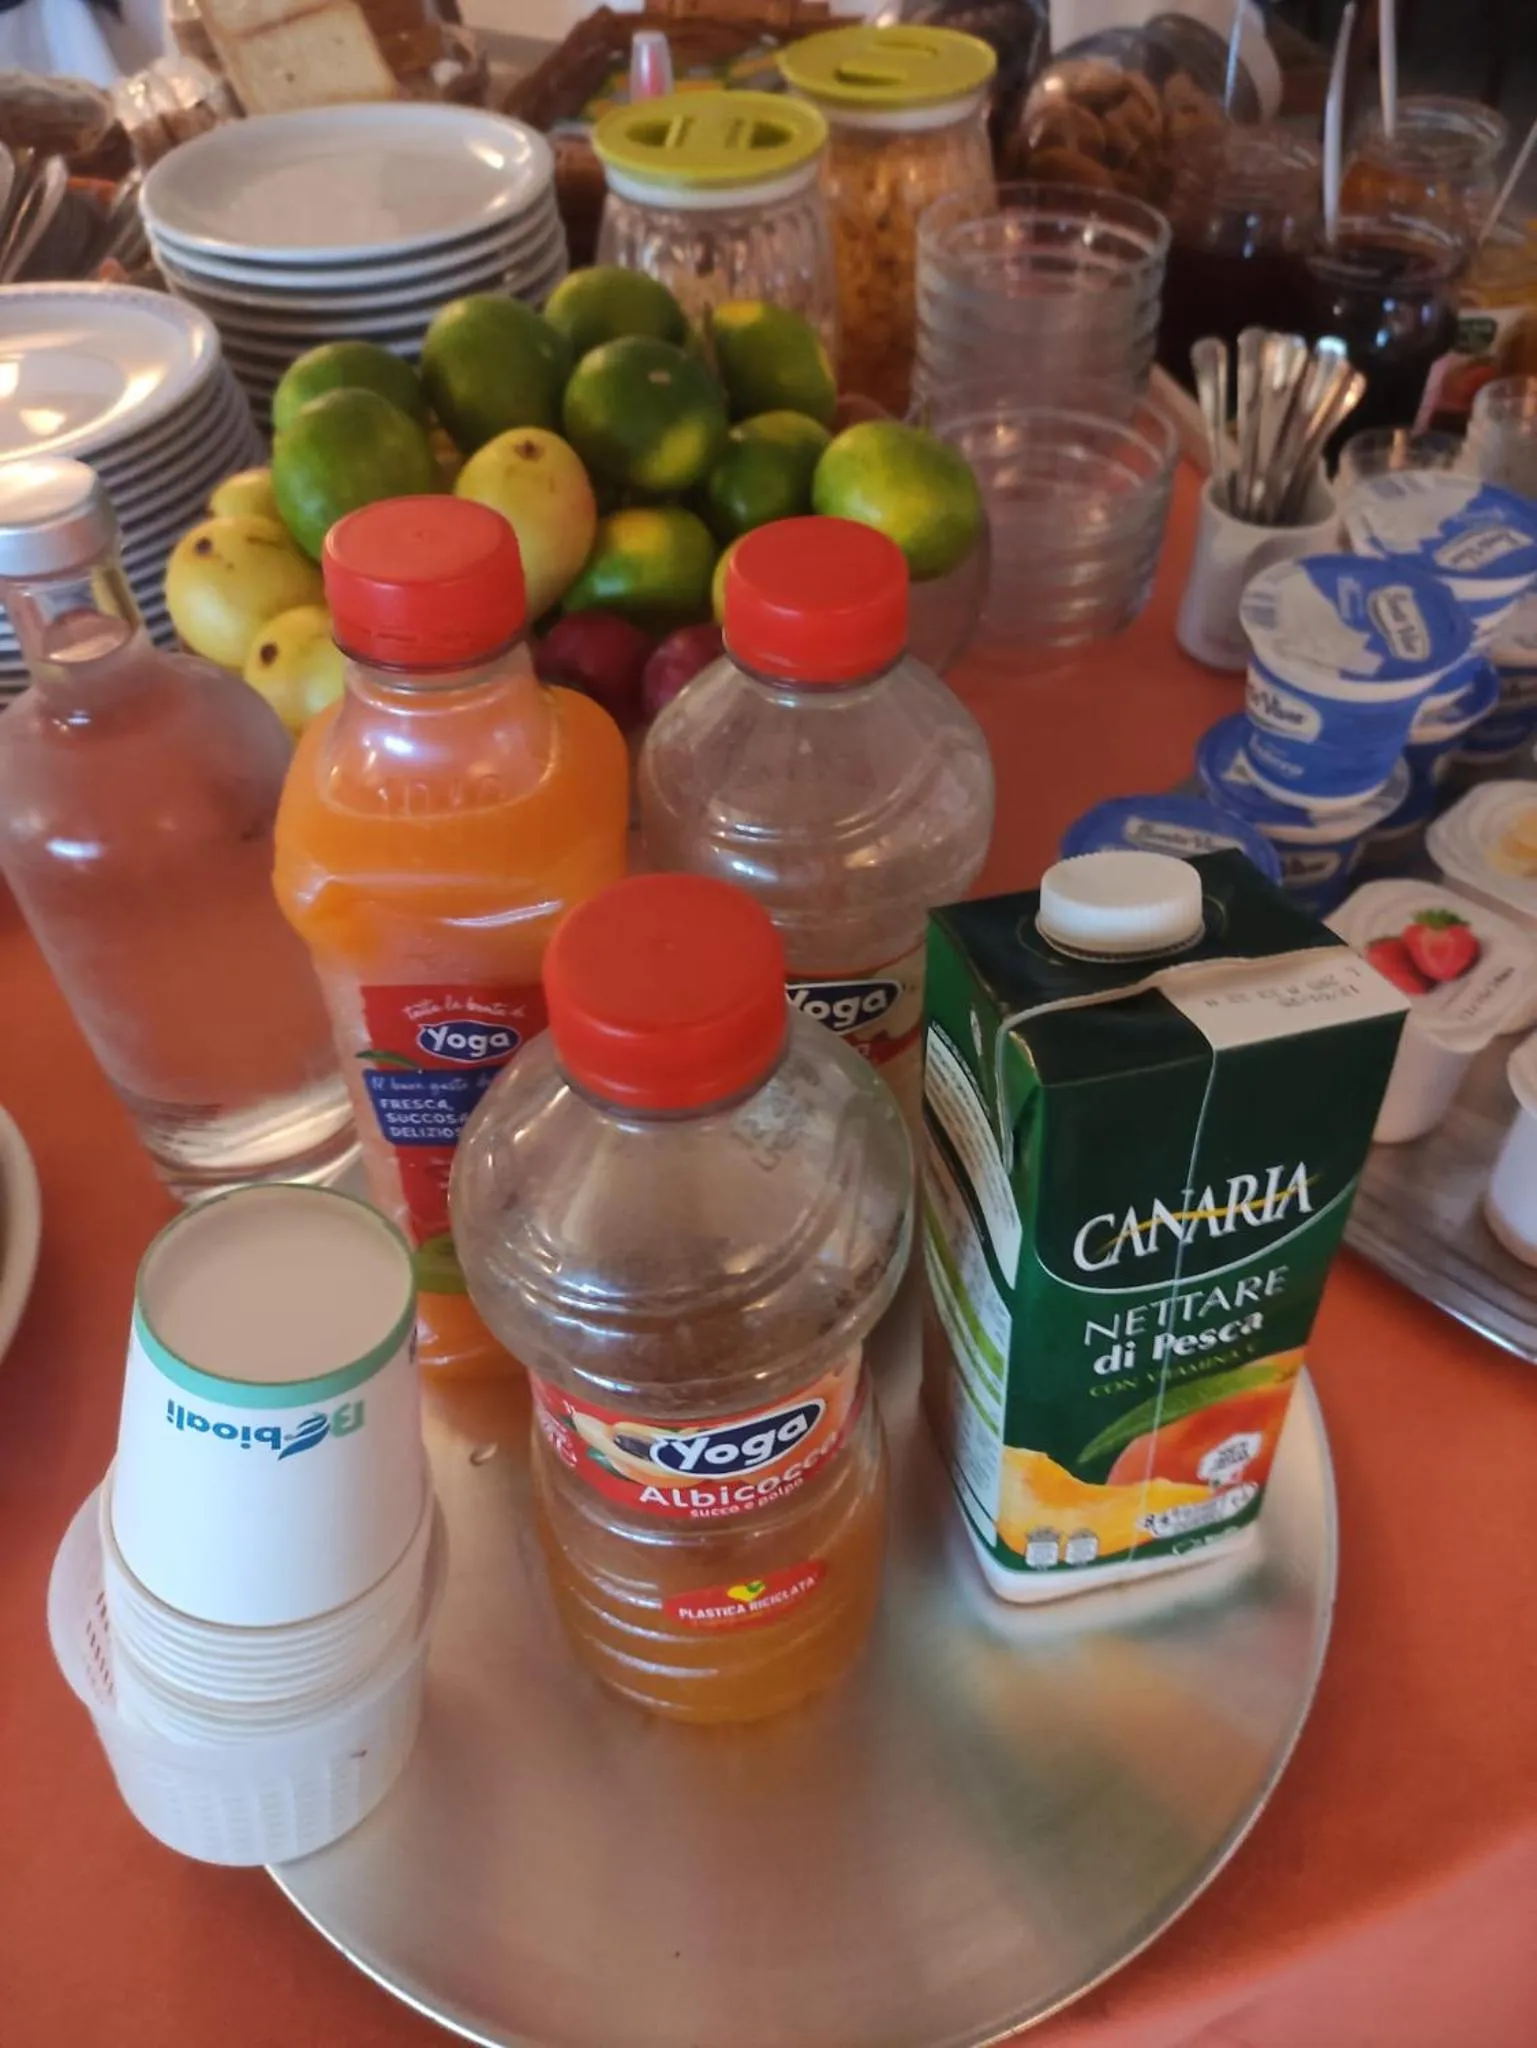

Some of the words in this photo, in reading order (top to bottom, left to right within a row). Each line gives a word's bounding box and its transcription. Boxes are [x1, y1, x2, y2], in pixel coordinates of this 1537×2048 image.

[427, 1026, 511, 1058] Yoga
[1073, 1161, 1314, 1272] CANARIA
[1084, 1265, 1289, 1346] NETTARE
[1093, 1341, 1136, 1375] di
[1152, 1311, 1264, 1360] Pesca
[671, 1413, 809, 1471] Yoga
[690, 1505, 740, 1518] succo
[678, 1603, 746, 1620] PLASTICA
[749, 1575, 816, 1612] RICICLATA
